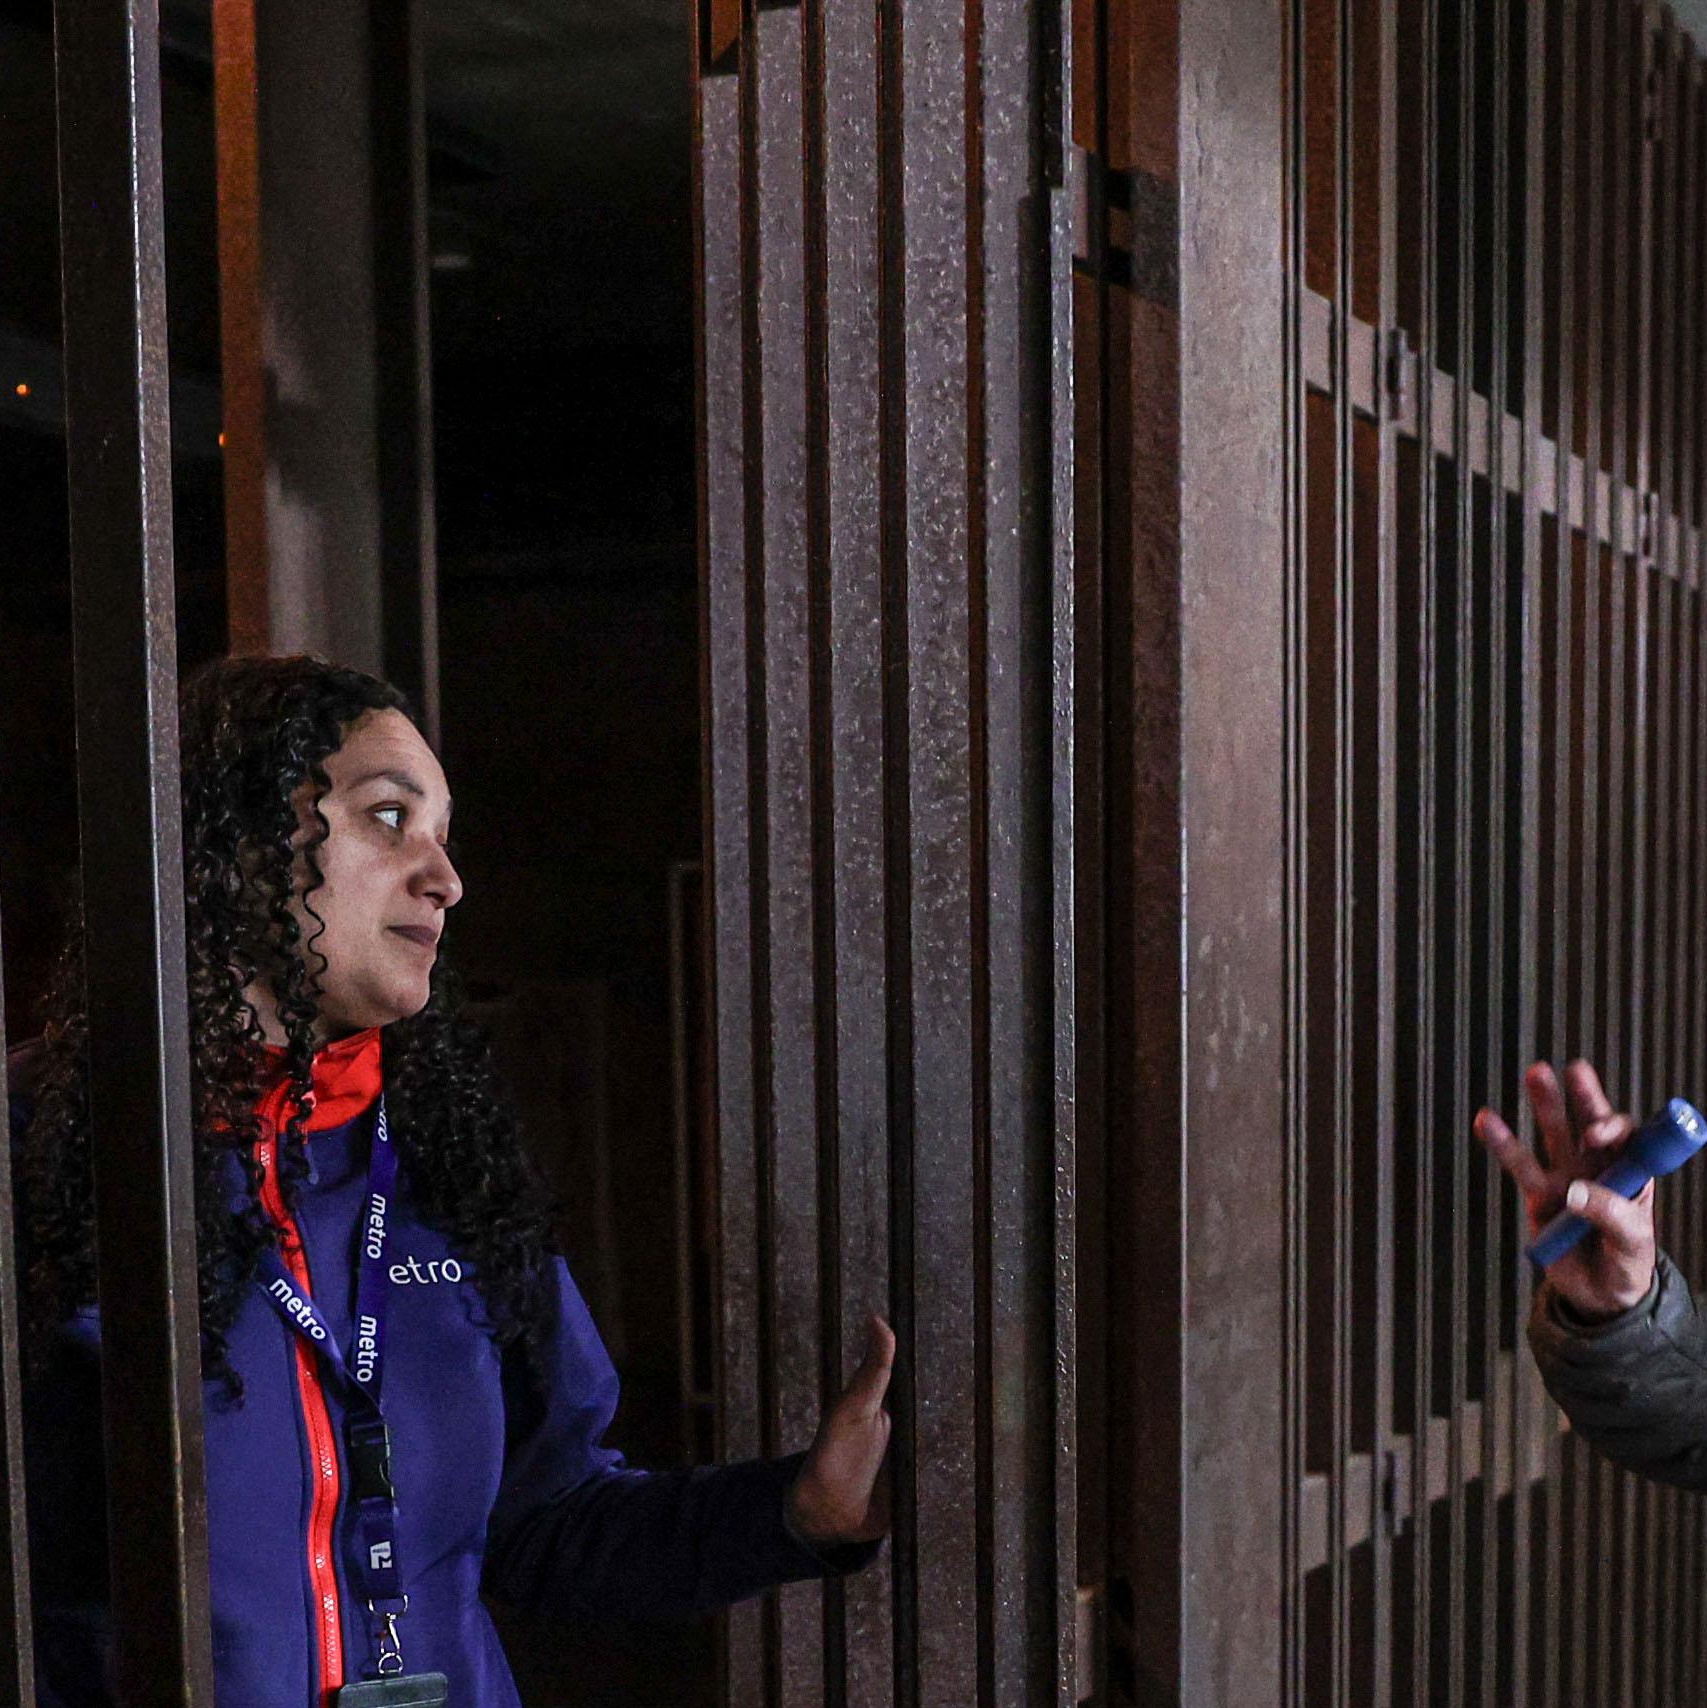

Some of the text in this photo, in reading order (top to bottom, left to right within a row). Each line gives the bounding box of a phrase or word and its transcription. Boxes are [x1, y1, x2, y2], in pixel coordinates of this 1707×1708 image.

[366, 1192, 387, 1260] metro
[388, 1254, 463, 1285] etro
[268, 1277, 327, 1341] metro
[356, 1313, 378, 1383] metro
